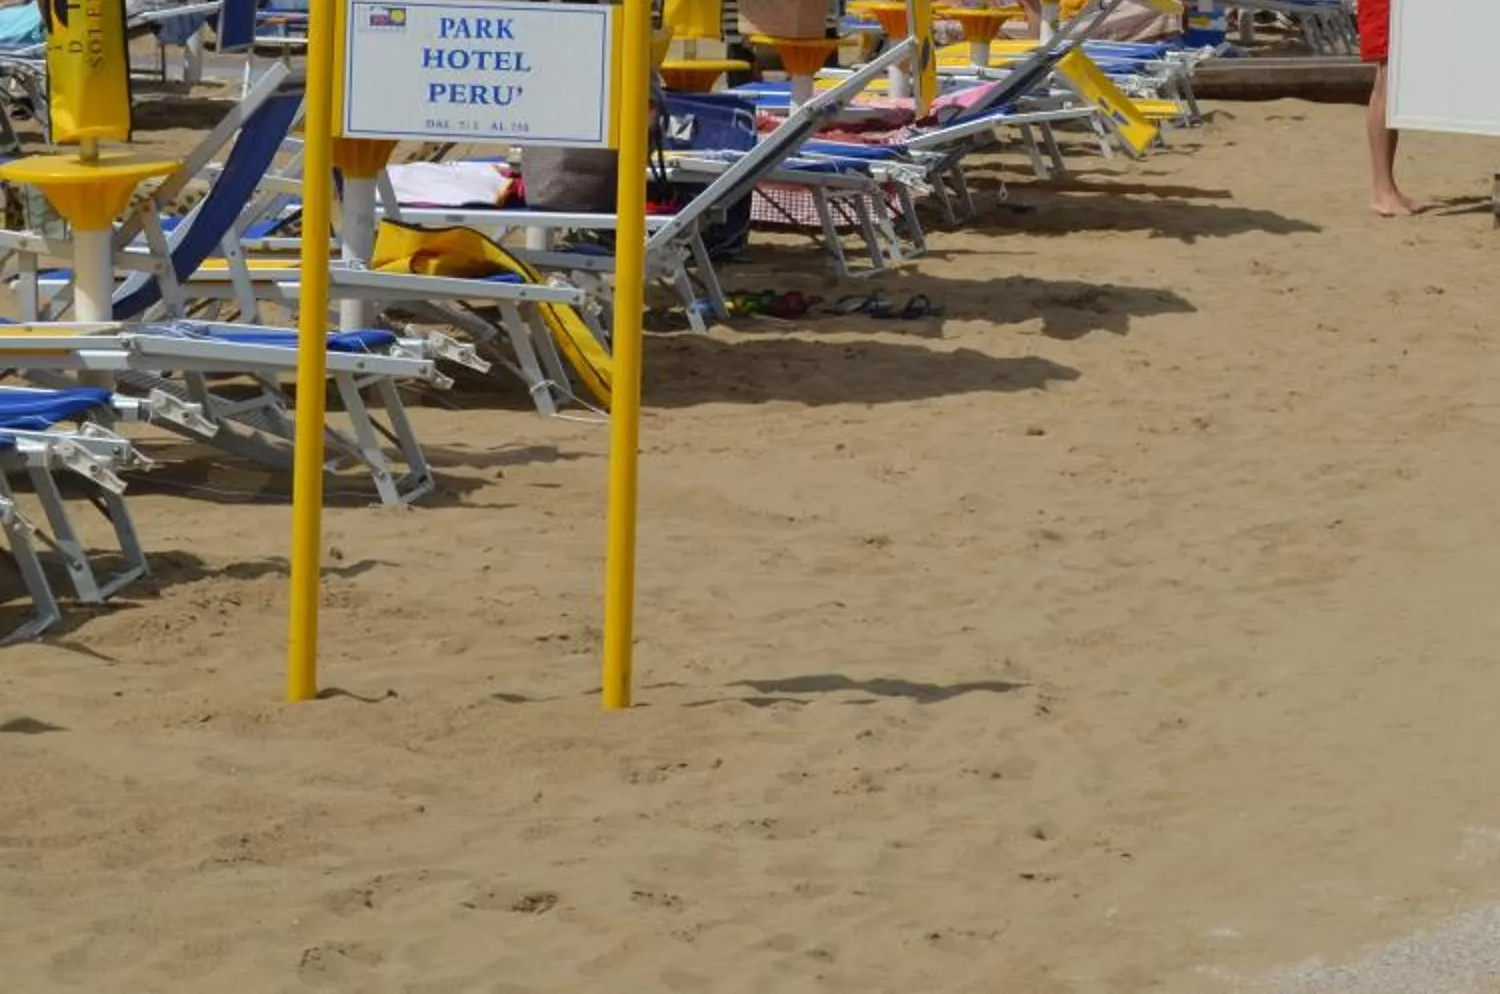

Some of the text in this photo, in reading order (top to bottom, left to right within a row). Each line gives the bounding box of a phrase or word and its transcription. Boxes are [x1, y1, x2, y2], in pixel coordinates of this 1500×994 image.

[440, 17, 515, 39] PARK
[422, 47, 531, 72] HOTEL
[428, 83, 522, 106] PERU'
